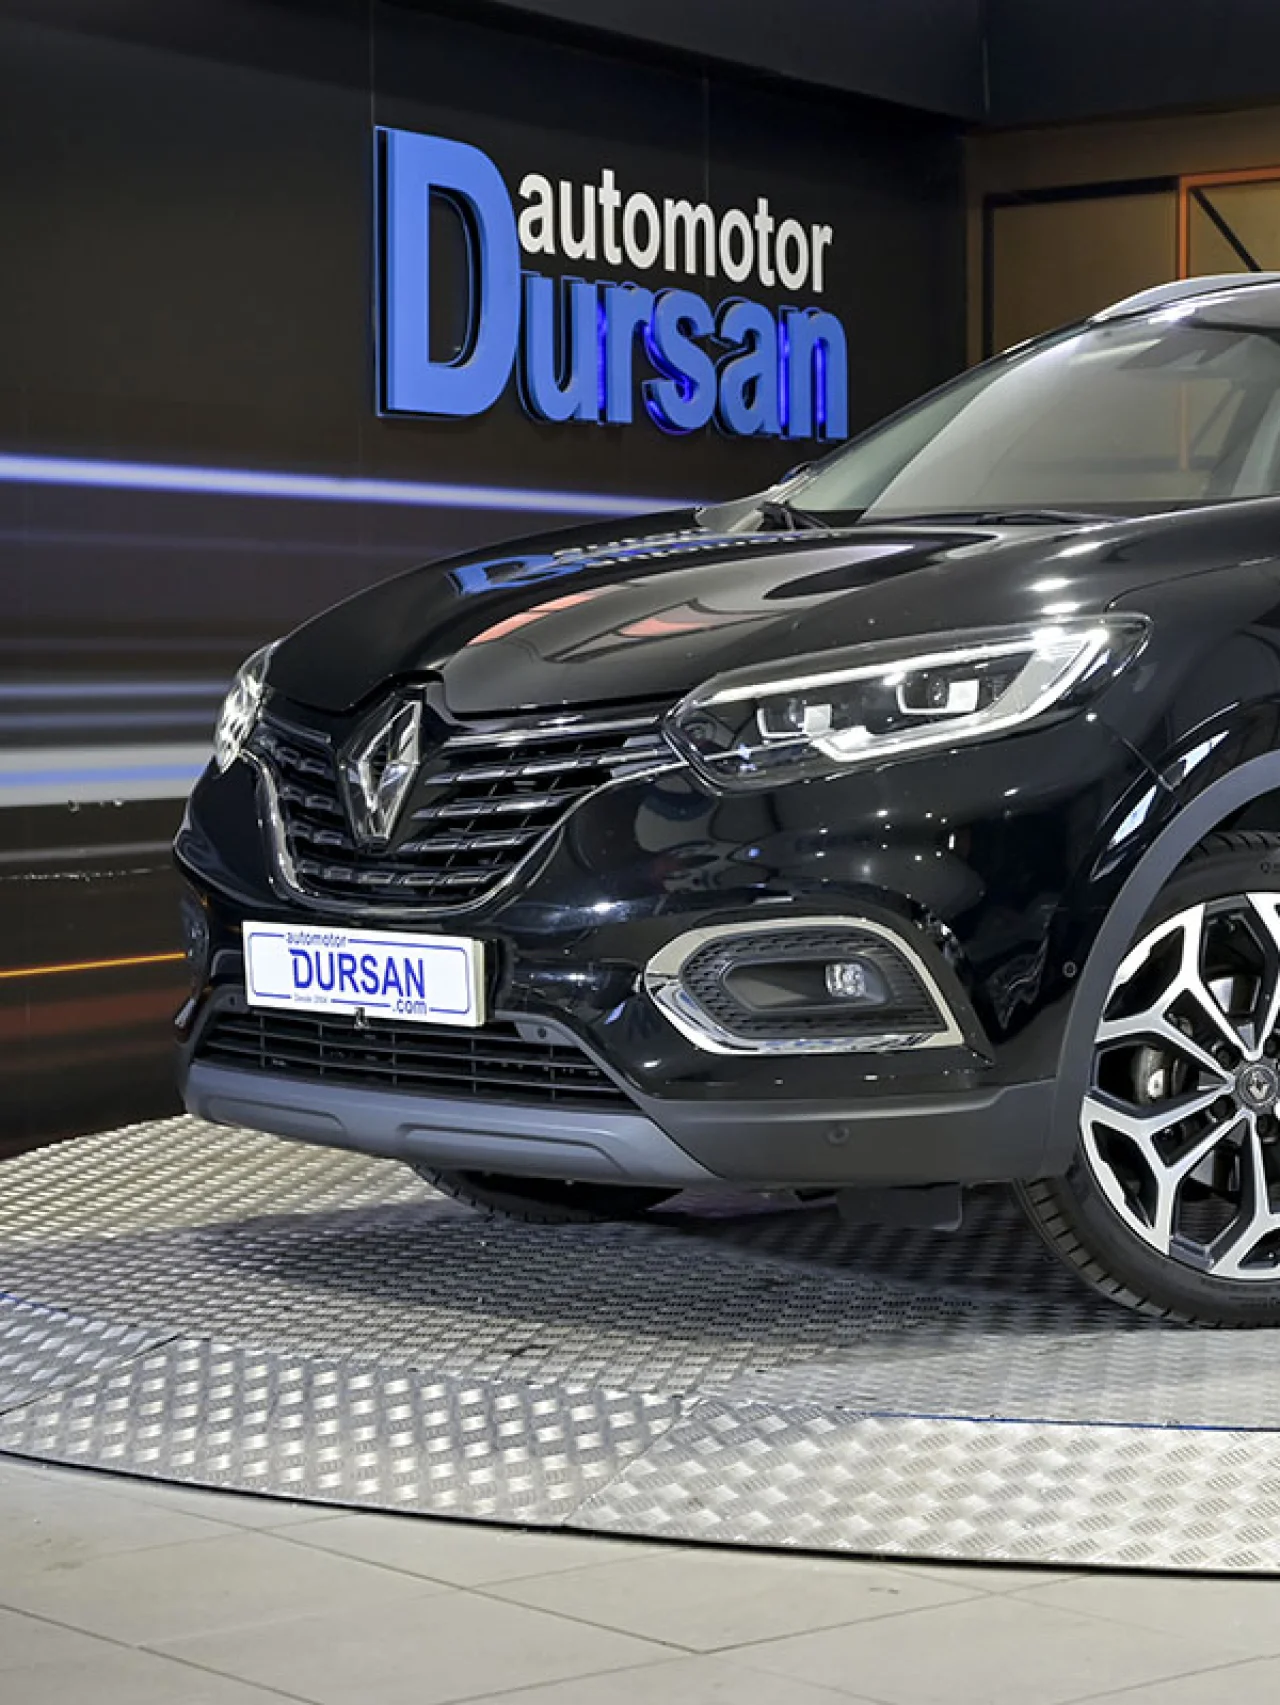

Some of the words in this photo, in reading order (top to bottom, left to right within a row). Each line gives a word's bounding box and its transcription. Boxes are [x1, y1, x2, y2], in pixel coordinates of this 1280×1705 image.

[517, 169, 833, 292] automotor
[374, 126, 848, 441] Dursan
[286, 931, 347, 947] automotor
[289, 948, 426, 999] DURSAN
[393, 999, 428, 1015] .com
